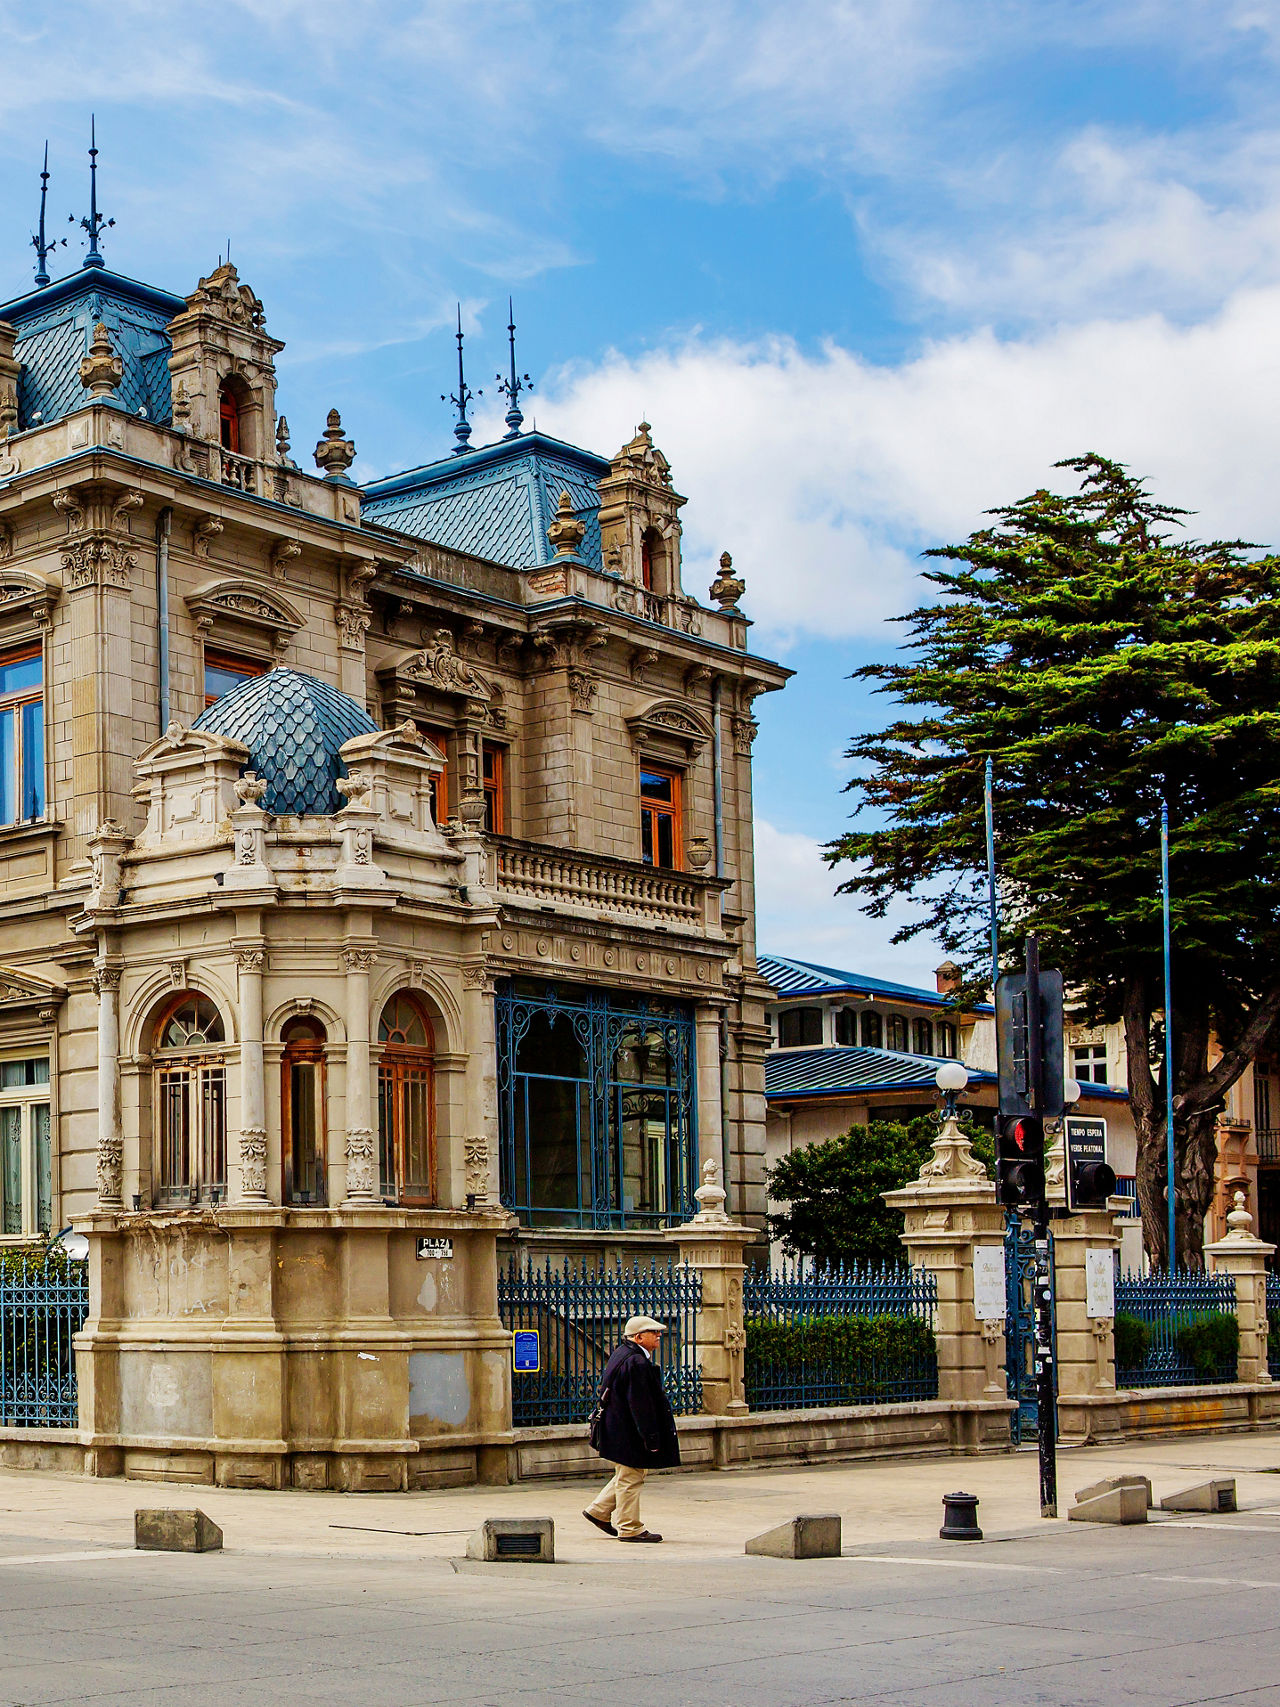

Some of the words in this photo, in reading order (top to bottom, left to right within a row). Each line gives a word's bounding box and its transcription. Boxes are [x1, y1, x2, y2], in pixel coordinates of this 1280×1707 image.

[1071, 1128, 1085, 1136] TIEMPO
[1087, 1128, 1102, 1137] ESPERA
[1071, 1144, 1082, 1152] VERDE
[1083, 1145, 1103, 1153] PEATONAL
[423, 1238, 450, 1248] PLAZA
